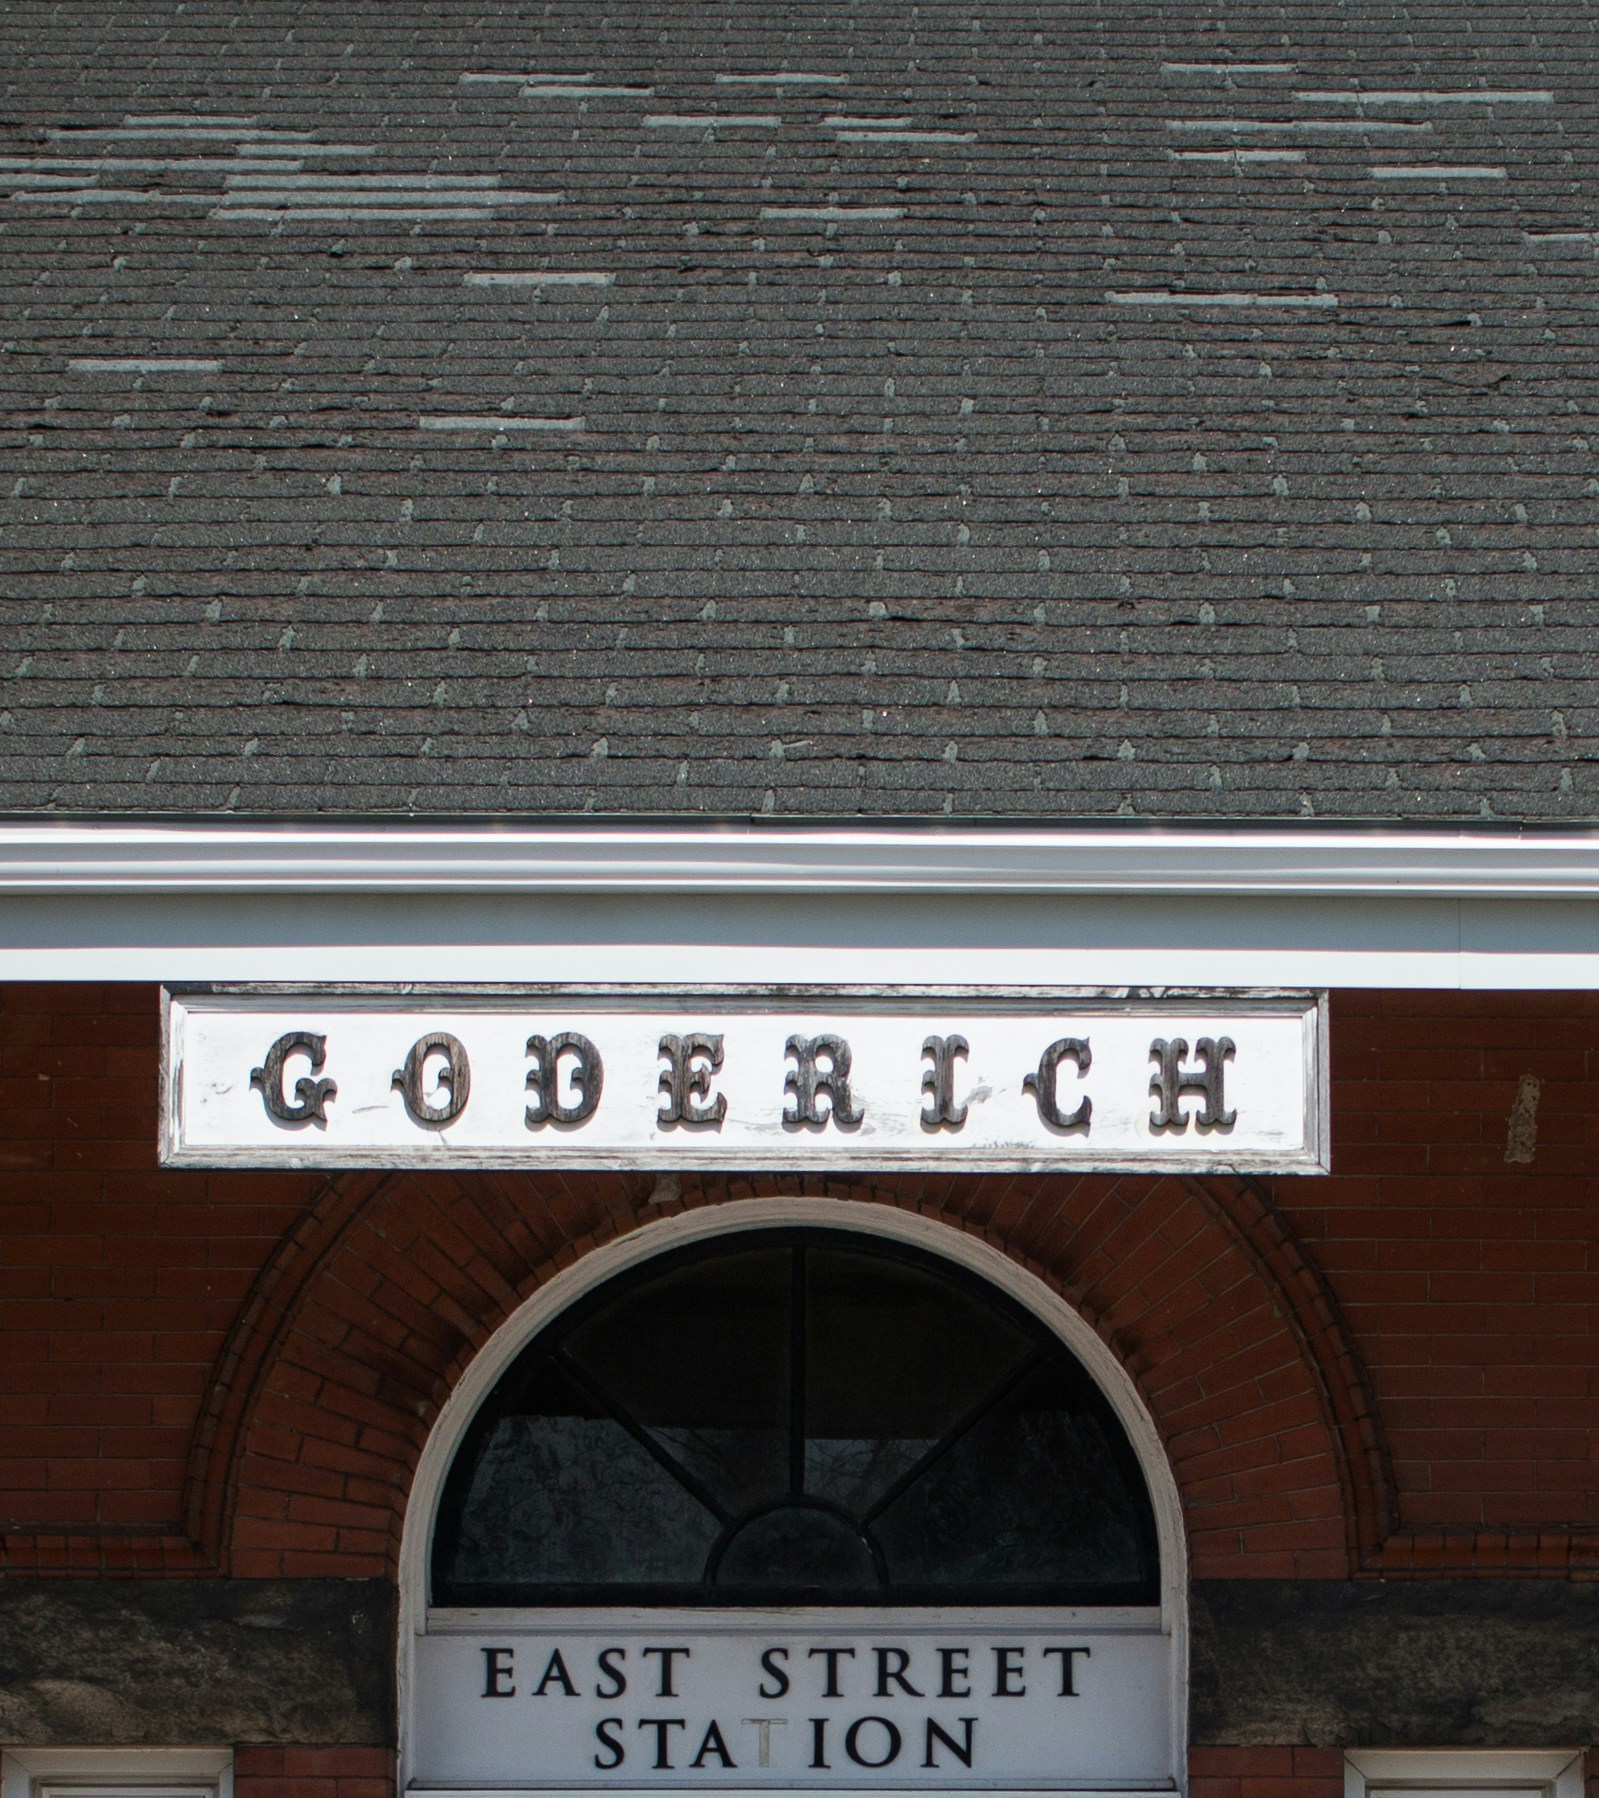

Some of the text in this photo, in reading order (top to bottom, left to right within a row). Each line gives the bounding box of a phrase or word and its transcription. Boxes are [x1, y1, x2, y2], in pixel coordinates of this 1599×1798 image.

[250, 1032, 1237, 1135] GODERICH
[481, 1647, 1090, 1699] EAST STREET
[595, 1716, 978, 1769] STATION
